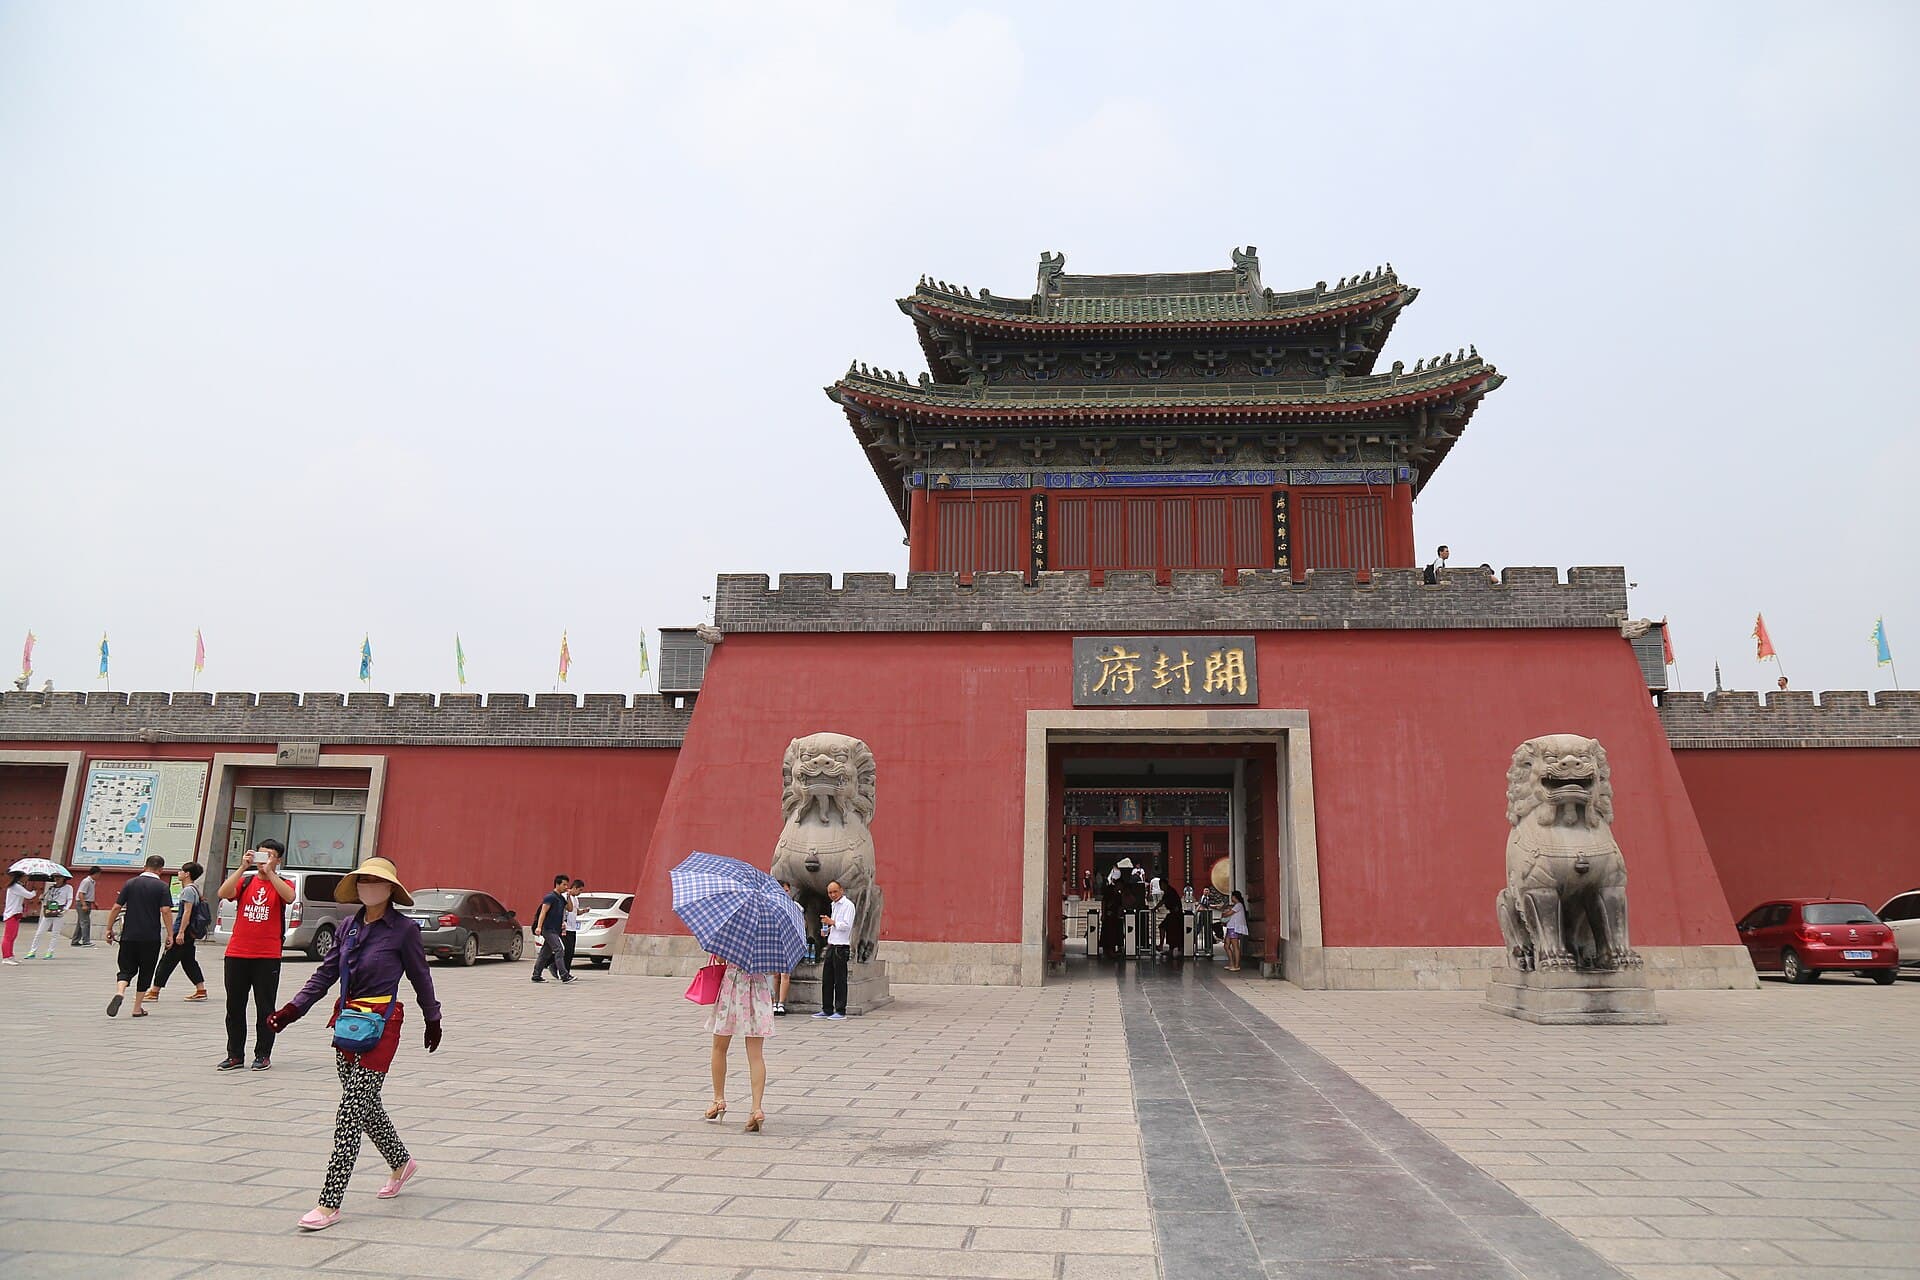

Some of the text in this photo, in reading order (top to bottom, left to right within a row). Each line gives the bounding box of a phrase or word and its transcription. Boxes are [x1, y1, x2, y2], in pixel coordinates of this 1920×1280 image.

[1092, 645, 1248, 696] 開封府
[244, 904, 269, 914] MARINE
[248, 911, 269, 921] BLUES
